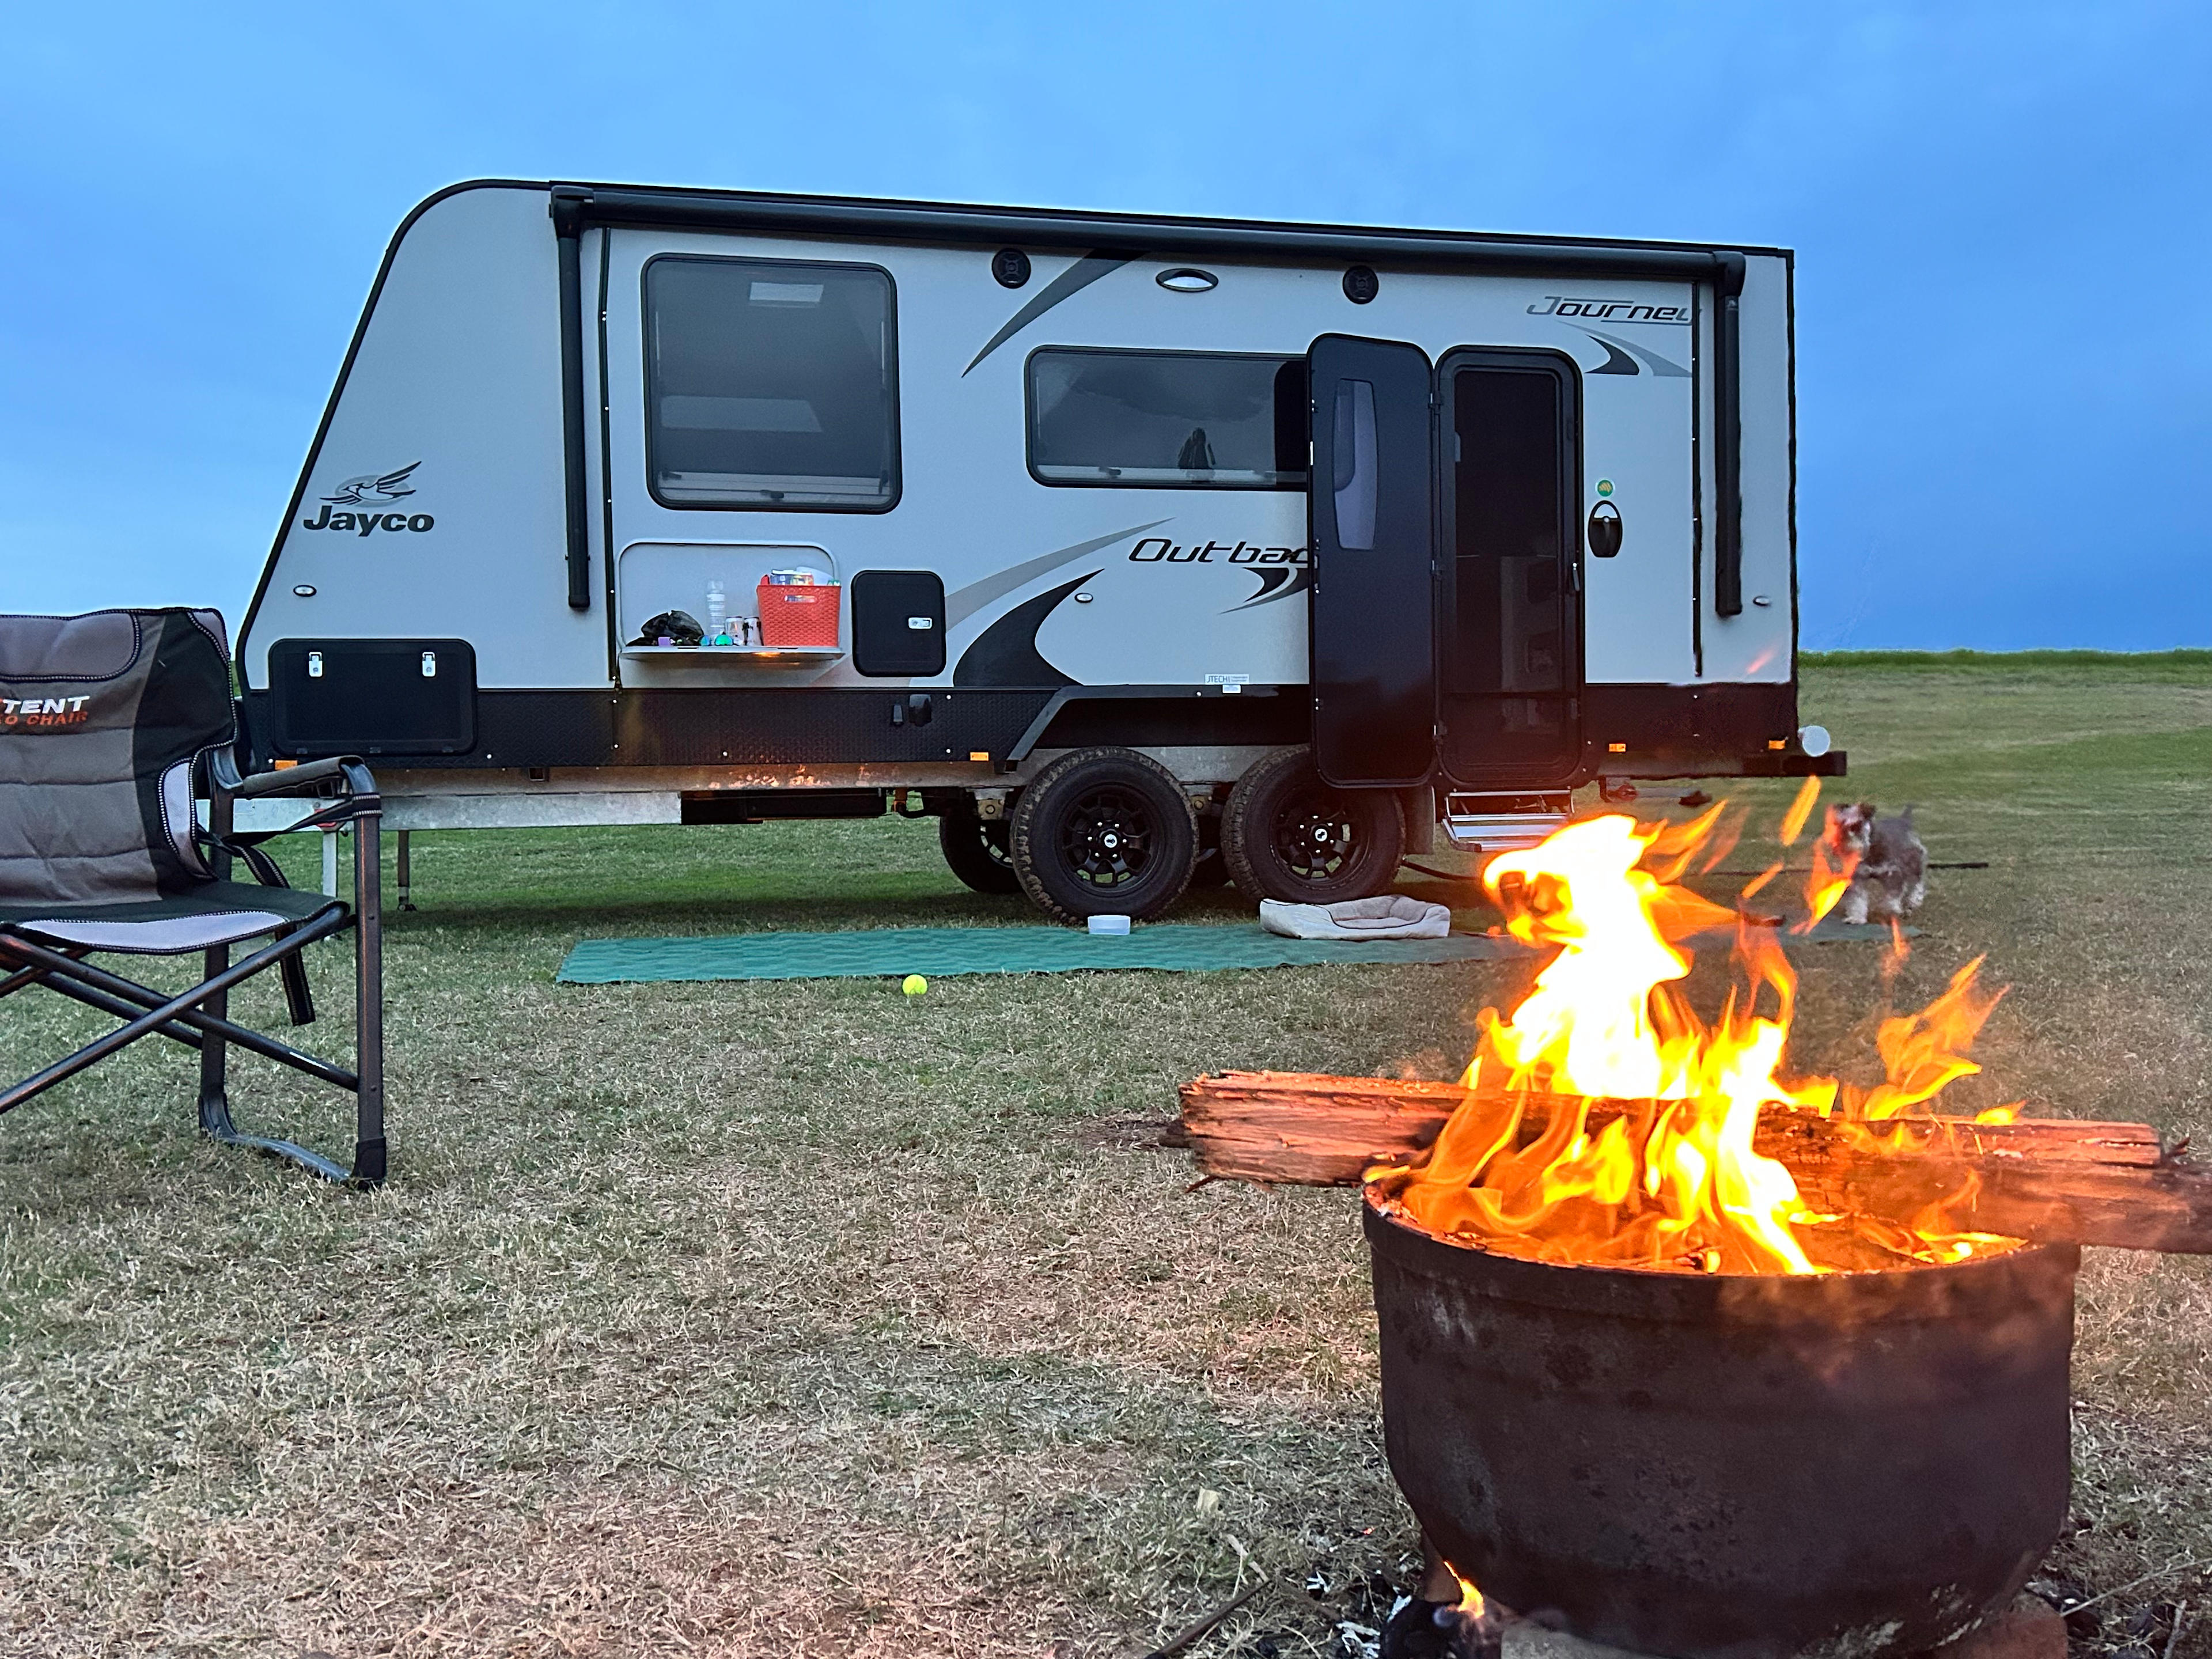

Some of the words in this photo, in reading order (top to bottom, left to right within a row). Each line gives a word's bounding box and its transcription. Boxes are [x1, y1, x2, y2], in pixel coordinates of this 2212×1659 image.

[303, 505, 435, 537] Jayco
[1128, 538, 1308, 563] Outbac
[0, 695, 90, 714] TENT
[26, 711, 88, 726] CHAIR
